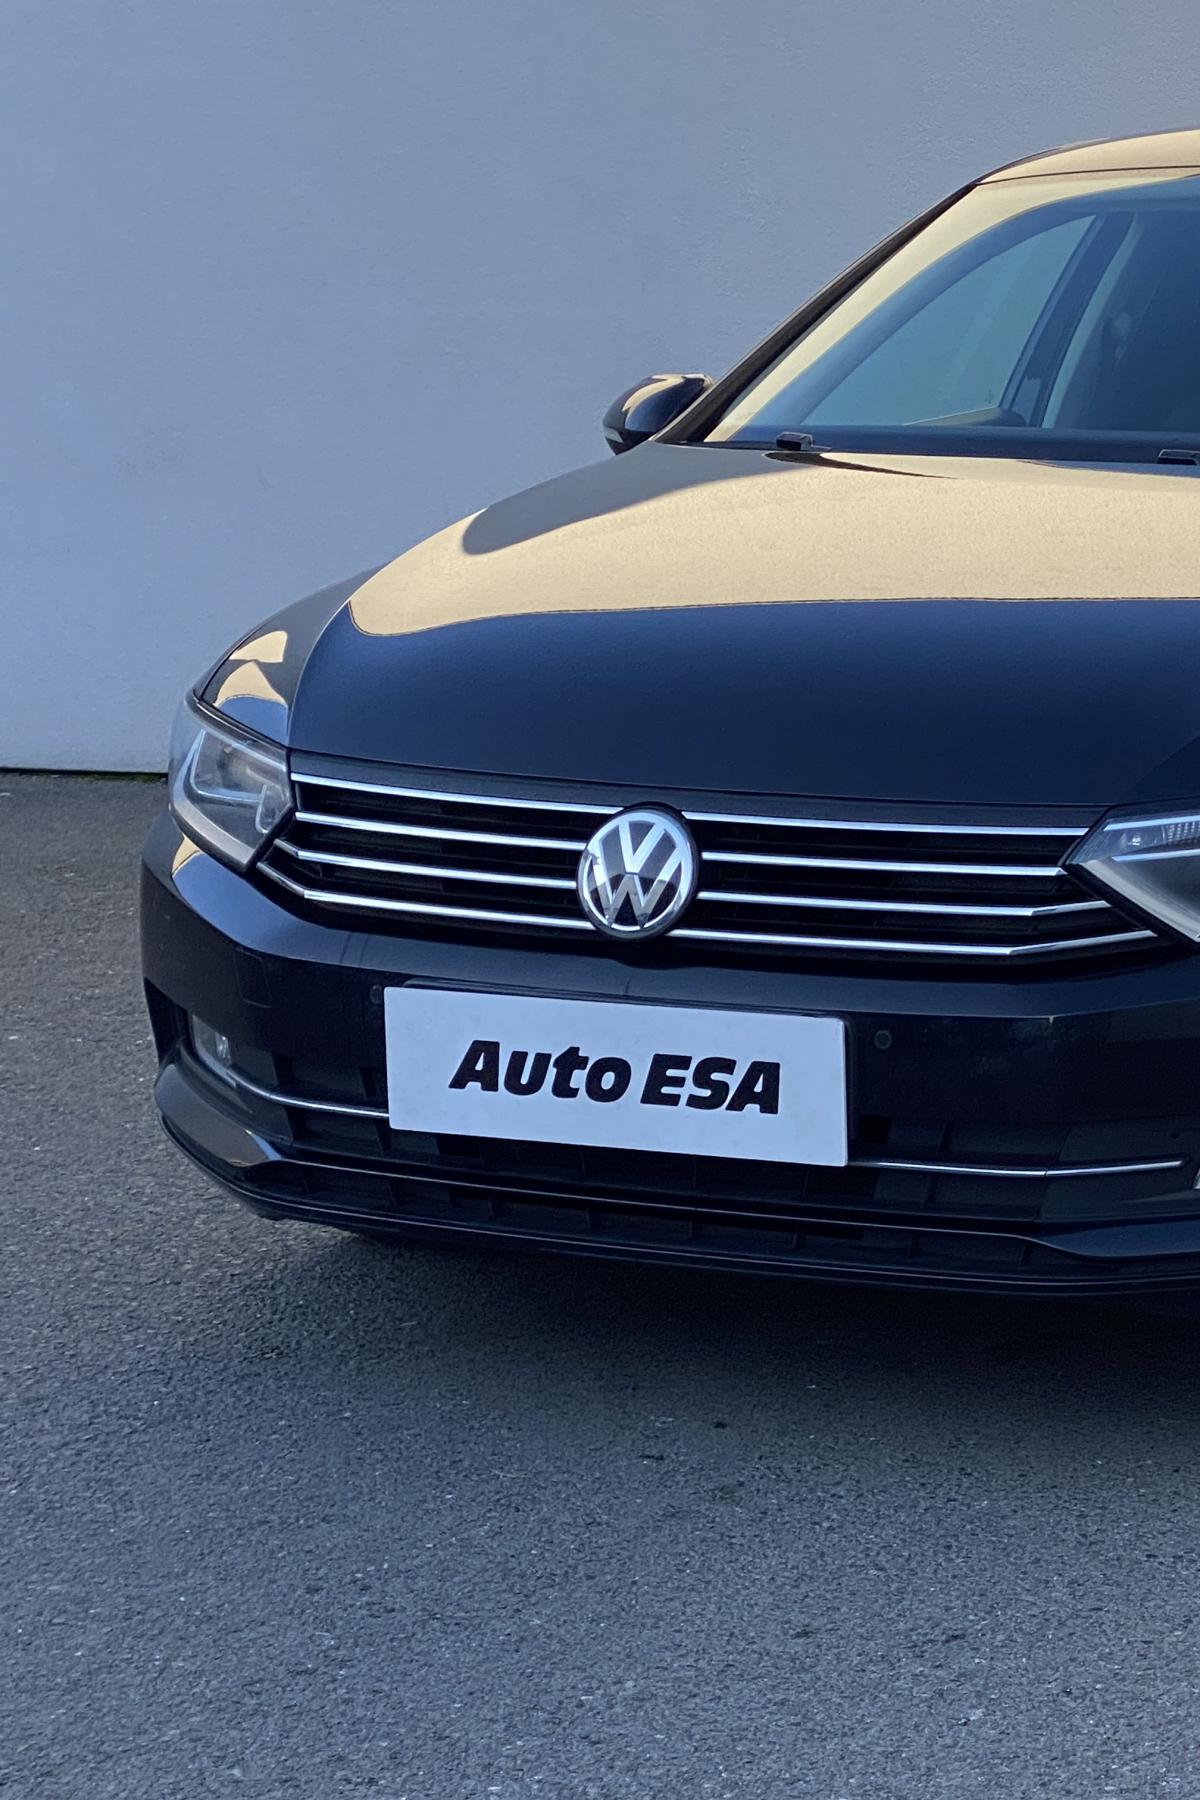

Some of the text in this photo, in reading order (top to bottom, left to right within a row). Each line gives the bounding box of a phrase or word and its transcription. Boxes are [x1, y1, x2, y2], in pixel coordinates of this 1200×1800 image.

[583, 810, 692, 932] VW
[448, 1039, 781, 1115] Auto ESA
